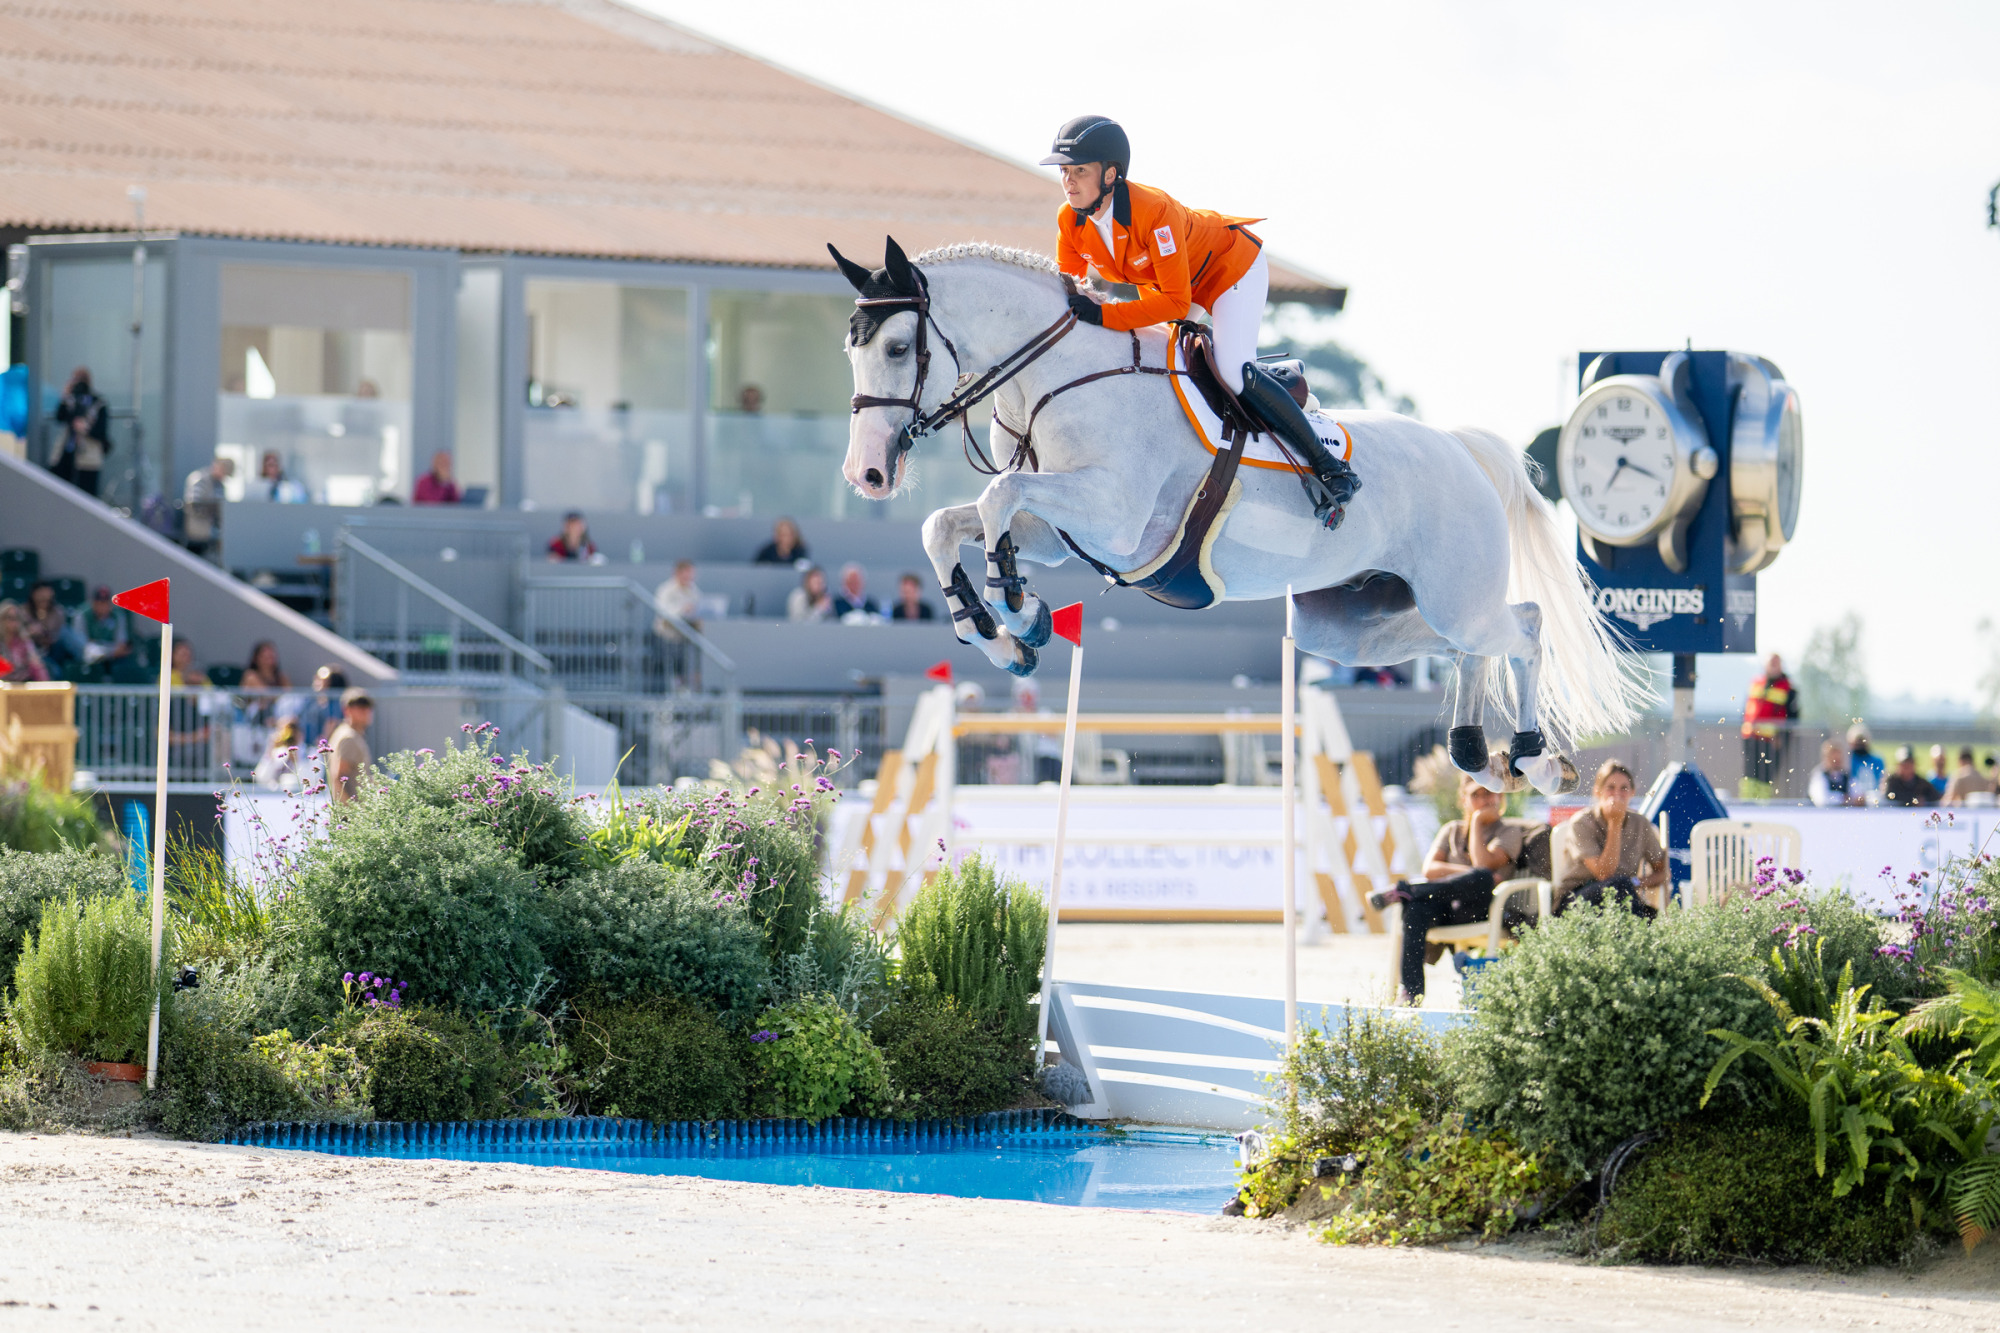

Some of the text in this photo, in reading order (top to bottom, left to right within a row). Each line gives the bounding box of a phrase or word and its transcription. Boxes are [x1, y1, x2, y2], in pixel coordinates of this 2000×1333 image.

[1618, 398, 1631, 411] 12
[1583, 426, 1596, 438] 10
[1657, 427, 1666, 439] 2
[1663, 454, 1673, 469] 3
[1656, 485, 1665, 497] 4
[1642, 505, 1651, 519] 5
[1619, 513, 1628, 526] 6
[1587, 587, 1704, 614] LONGINES
